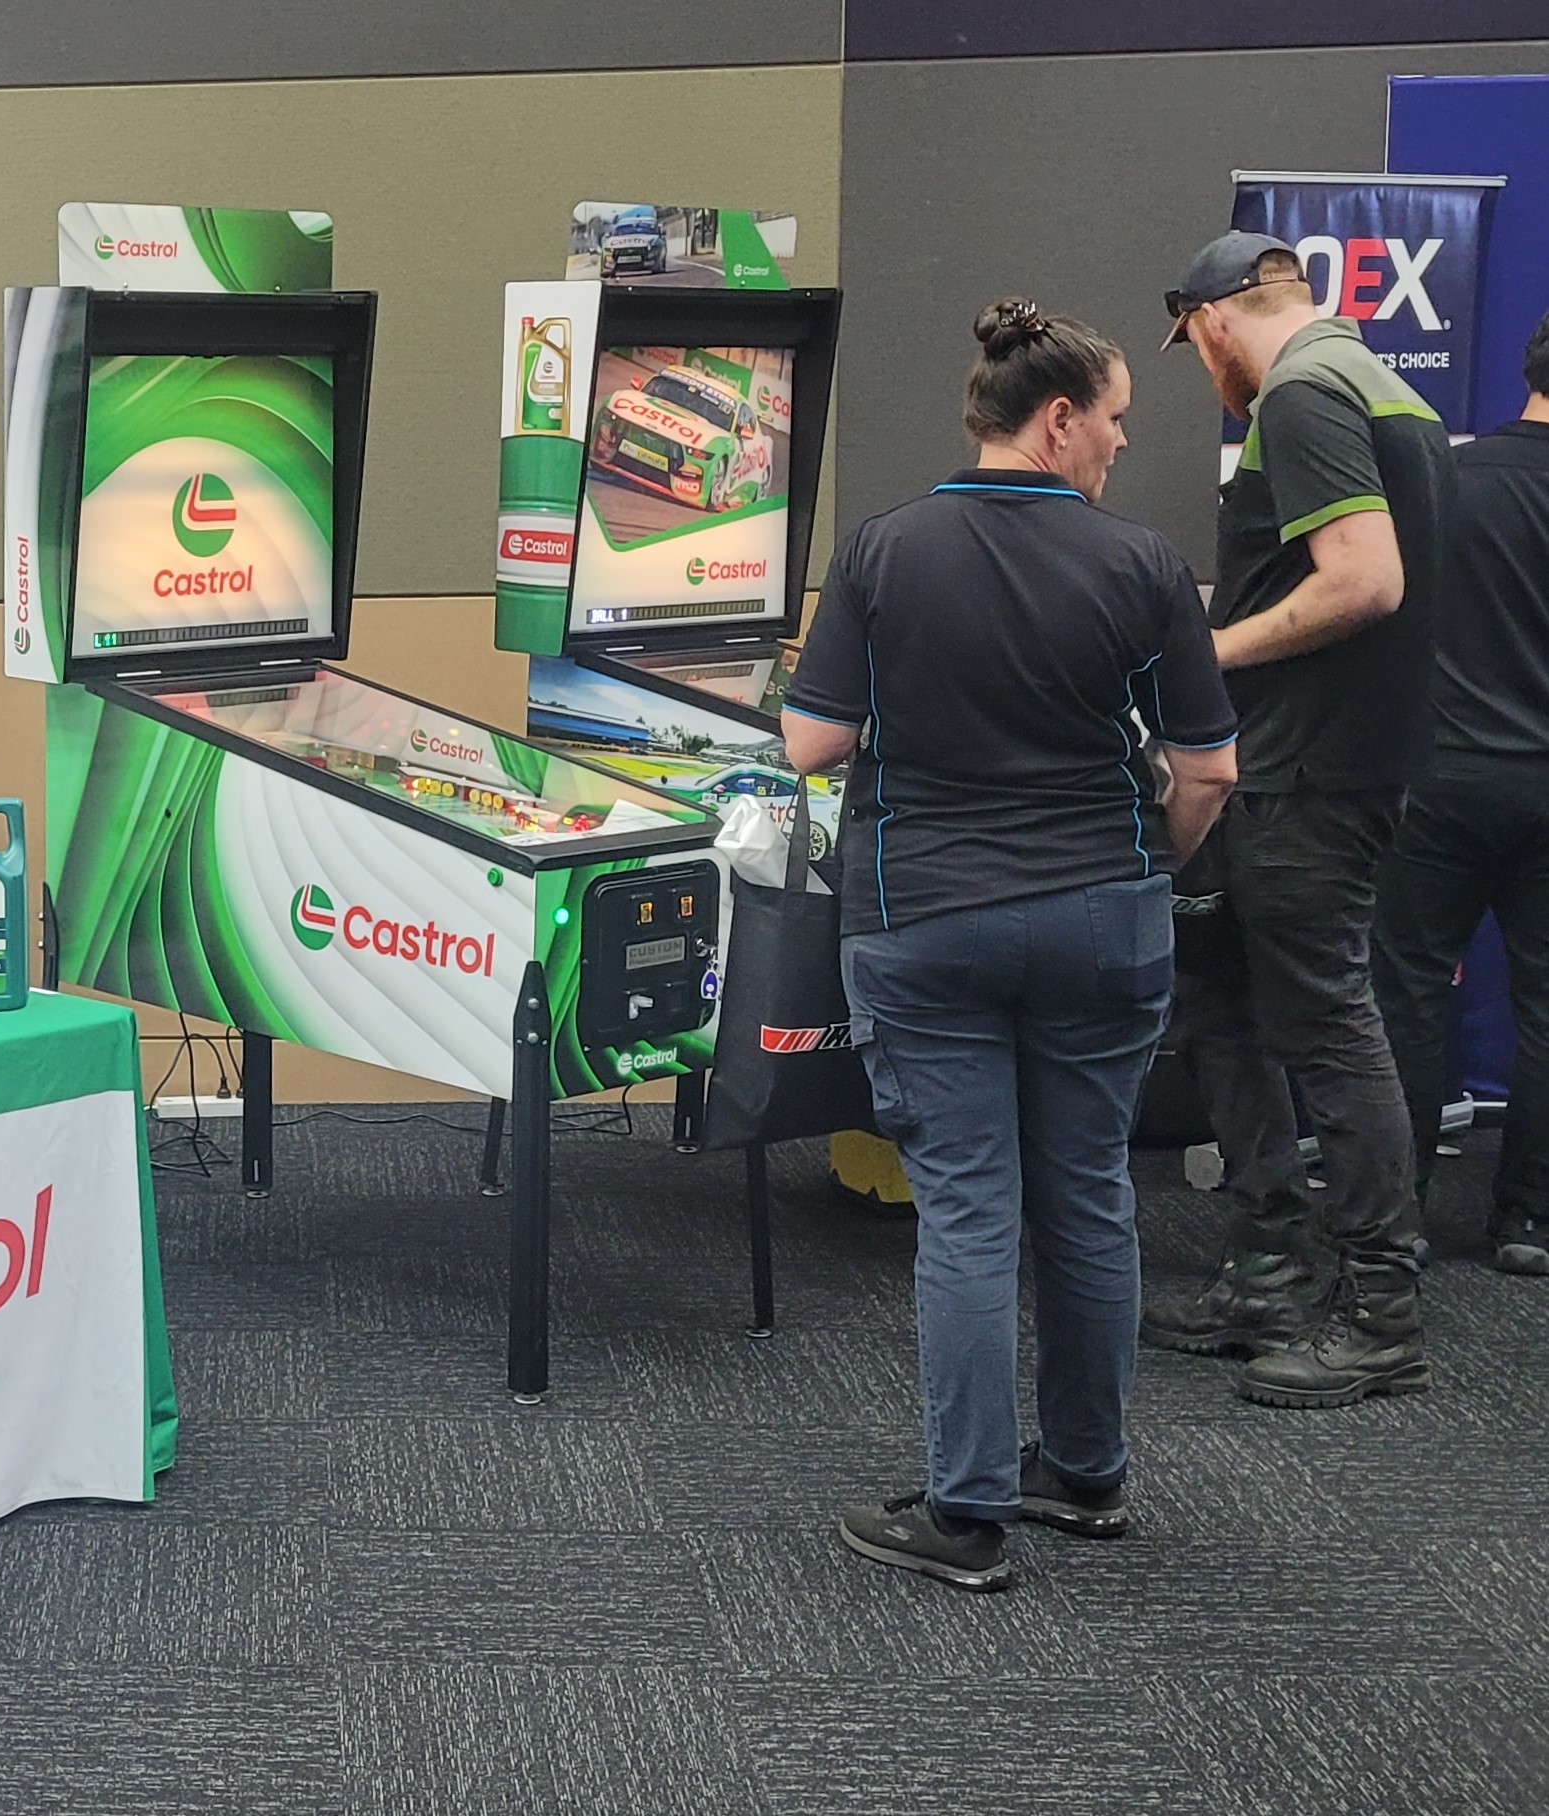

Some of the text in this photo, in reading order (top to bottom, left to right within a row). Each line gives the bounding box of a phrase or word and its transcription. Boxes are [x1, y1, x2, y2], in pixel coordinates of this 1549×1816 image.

[118, 238, 178, 259] Castrol
[1294, 235, 1445, 331] OEX
[1398, 351, 1450, 369] CHOICE
[613, 398, 703, 446] Castrol
[524, 538, 568, 557] Castrol
[17, 536, 30, 624] Castrol
[153, 565, 254, 598] Castrol
[708, 558, 767, 580] Castrol
[429, 737, 484, 765] Castrol
[342, 904, 495, 978] Castrol
[633, 1046, 678, 1071] Castrol
